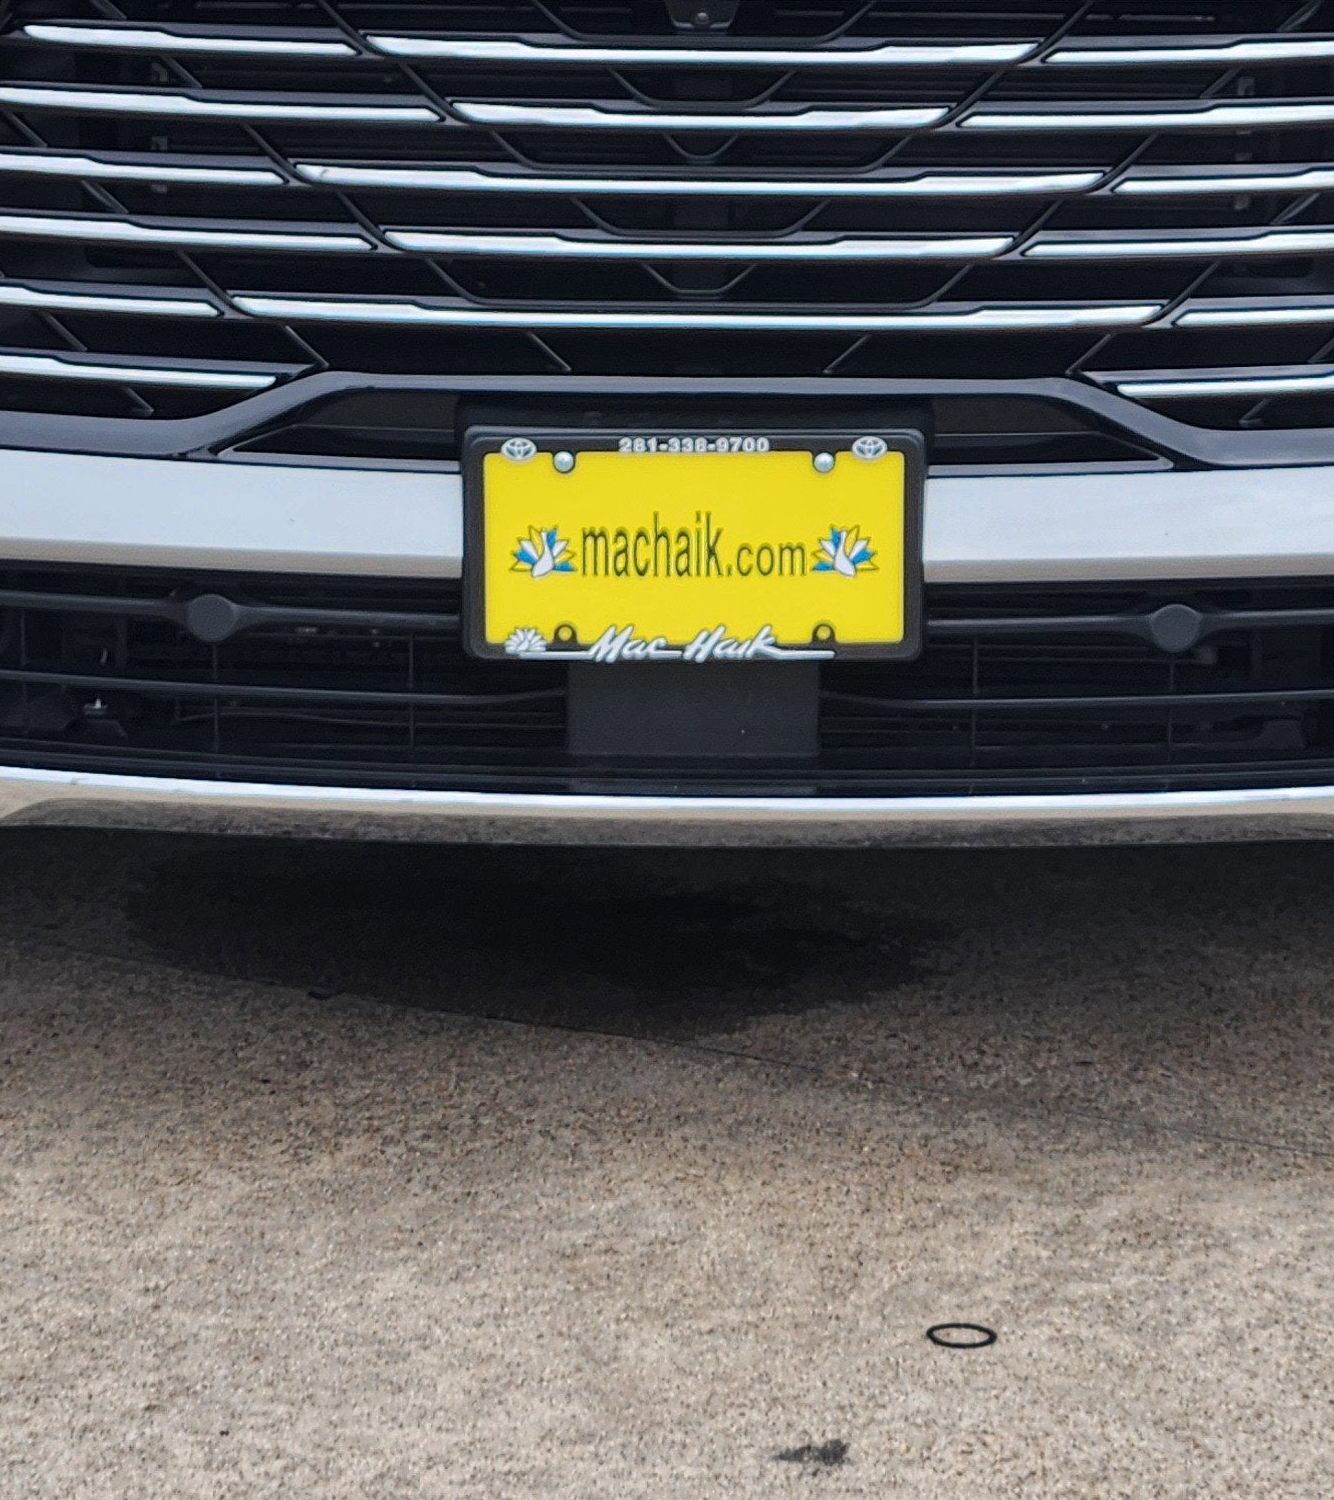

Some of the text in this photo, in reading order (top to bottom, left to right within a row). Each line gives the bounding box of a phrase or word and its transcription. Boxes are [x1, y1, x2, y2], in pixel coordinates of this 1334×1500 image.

[618, 436, 770, 454] 281-338-9700
[581, 509, 806, 577] machaik.com
[588, 623, 788, 664] Mac Haik
